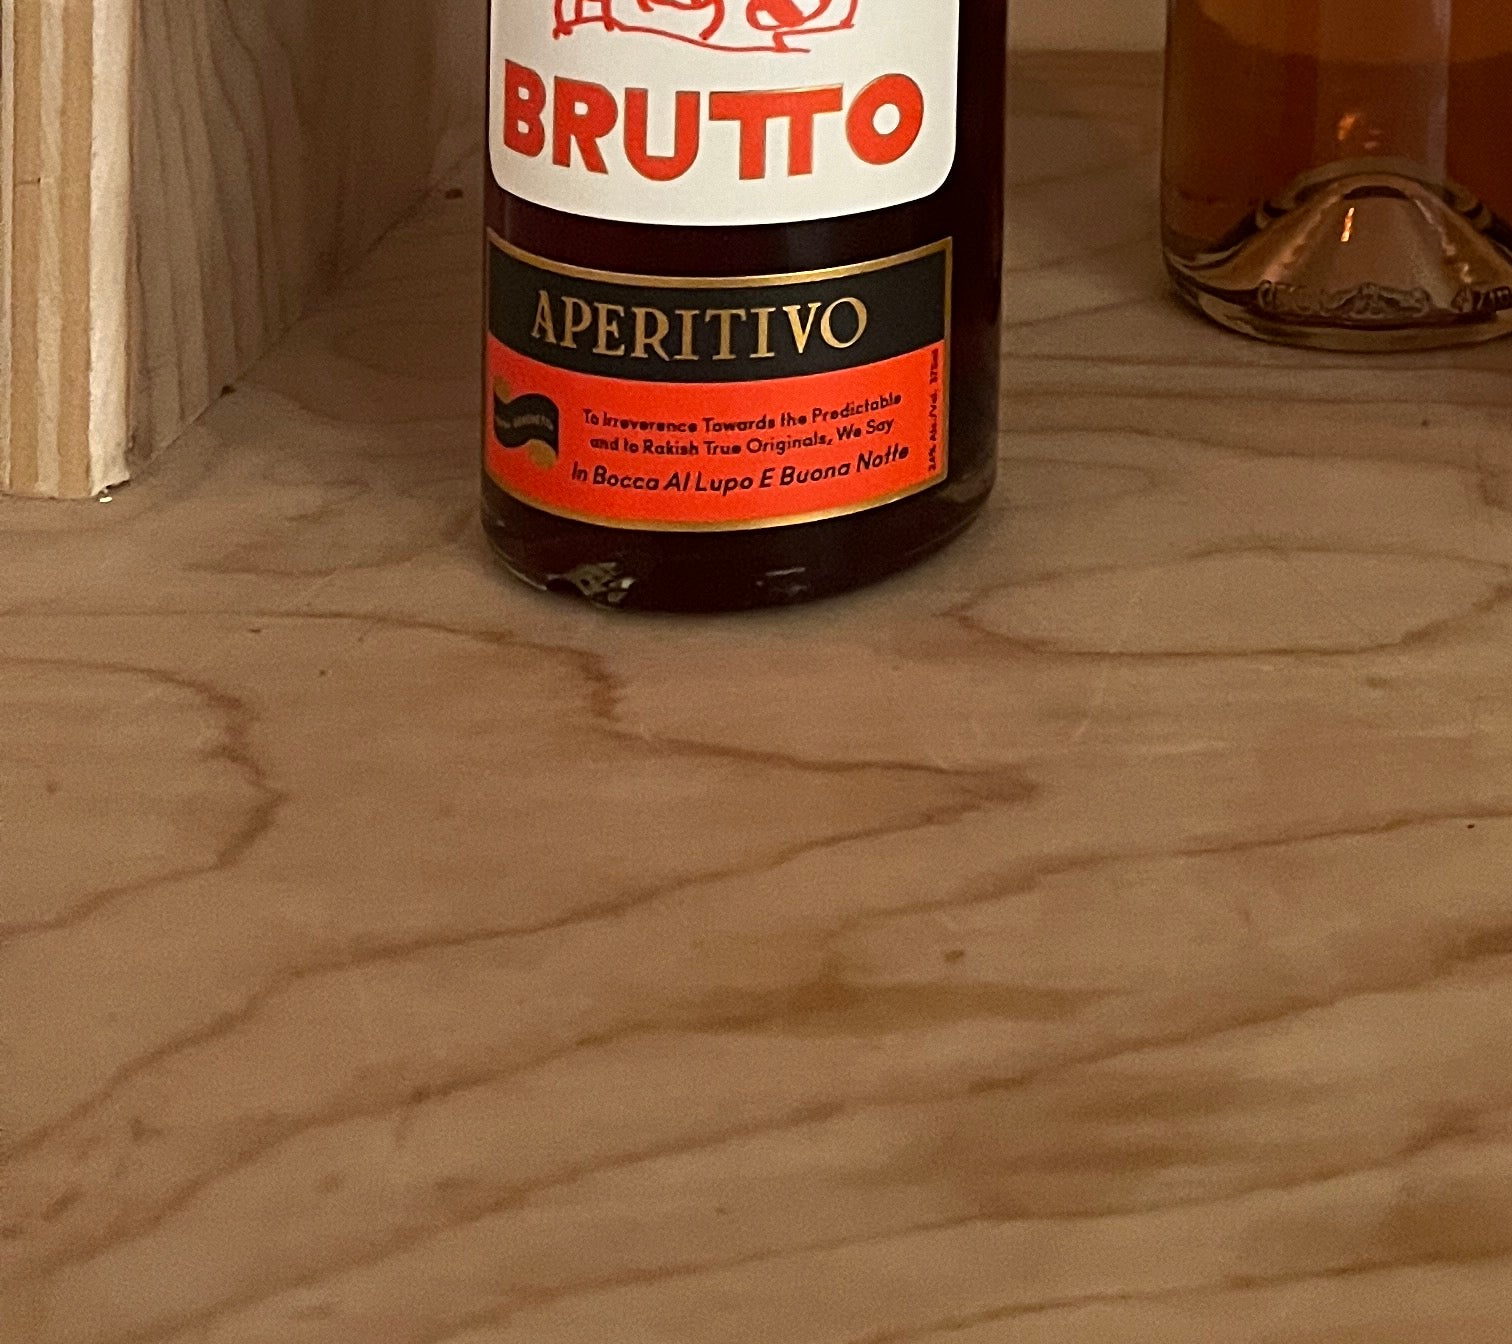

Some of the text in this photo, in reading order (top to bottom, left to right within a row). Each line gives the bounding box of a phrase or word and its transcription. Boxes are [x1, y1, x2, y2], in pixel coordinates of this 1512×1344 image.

[502, 58, 926, 182] BRUTTO
[531, 290, 868, 362] APERITIVO
[582, 392, 902, 434] To Irreverence Towards the Predictable
[589, 417, 895, 456] and to Rakish True Originals, We Say
[570, 443, 911, 497] In Bocca Al Lupo E Buona Notte
